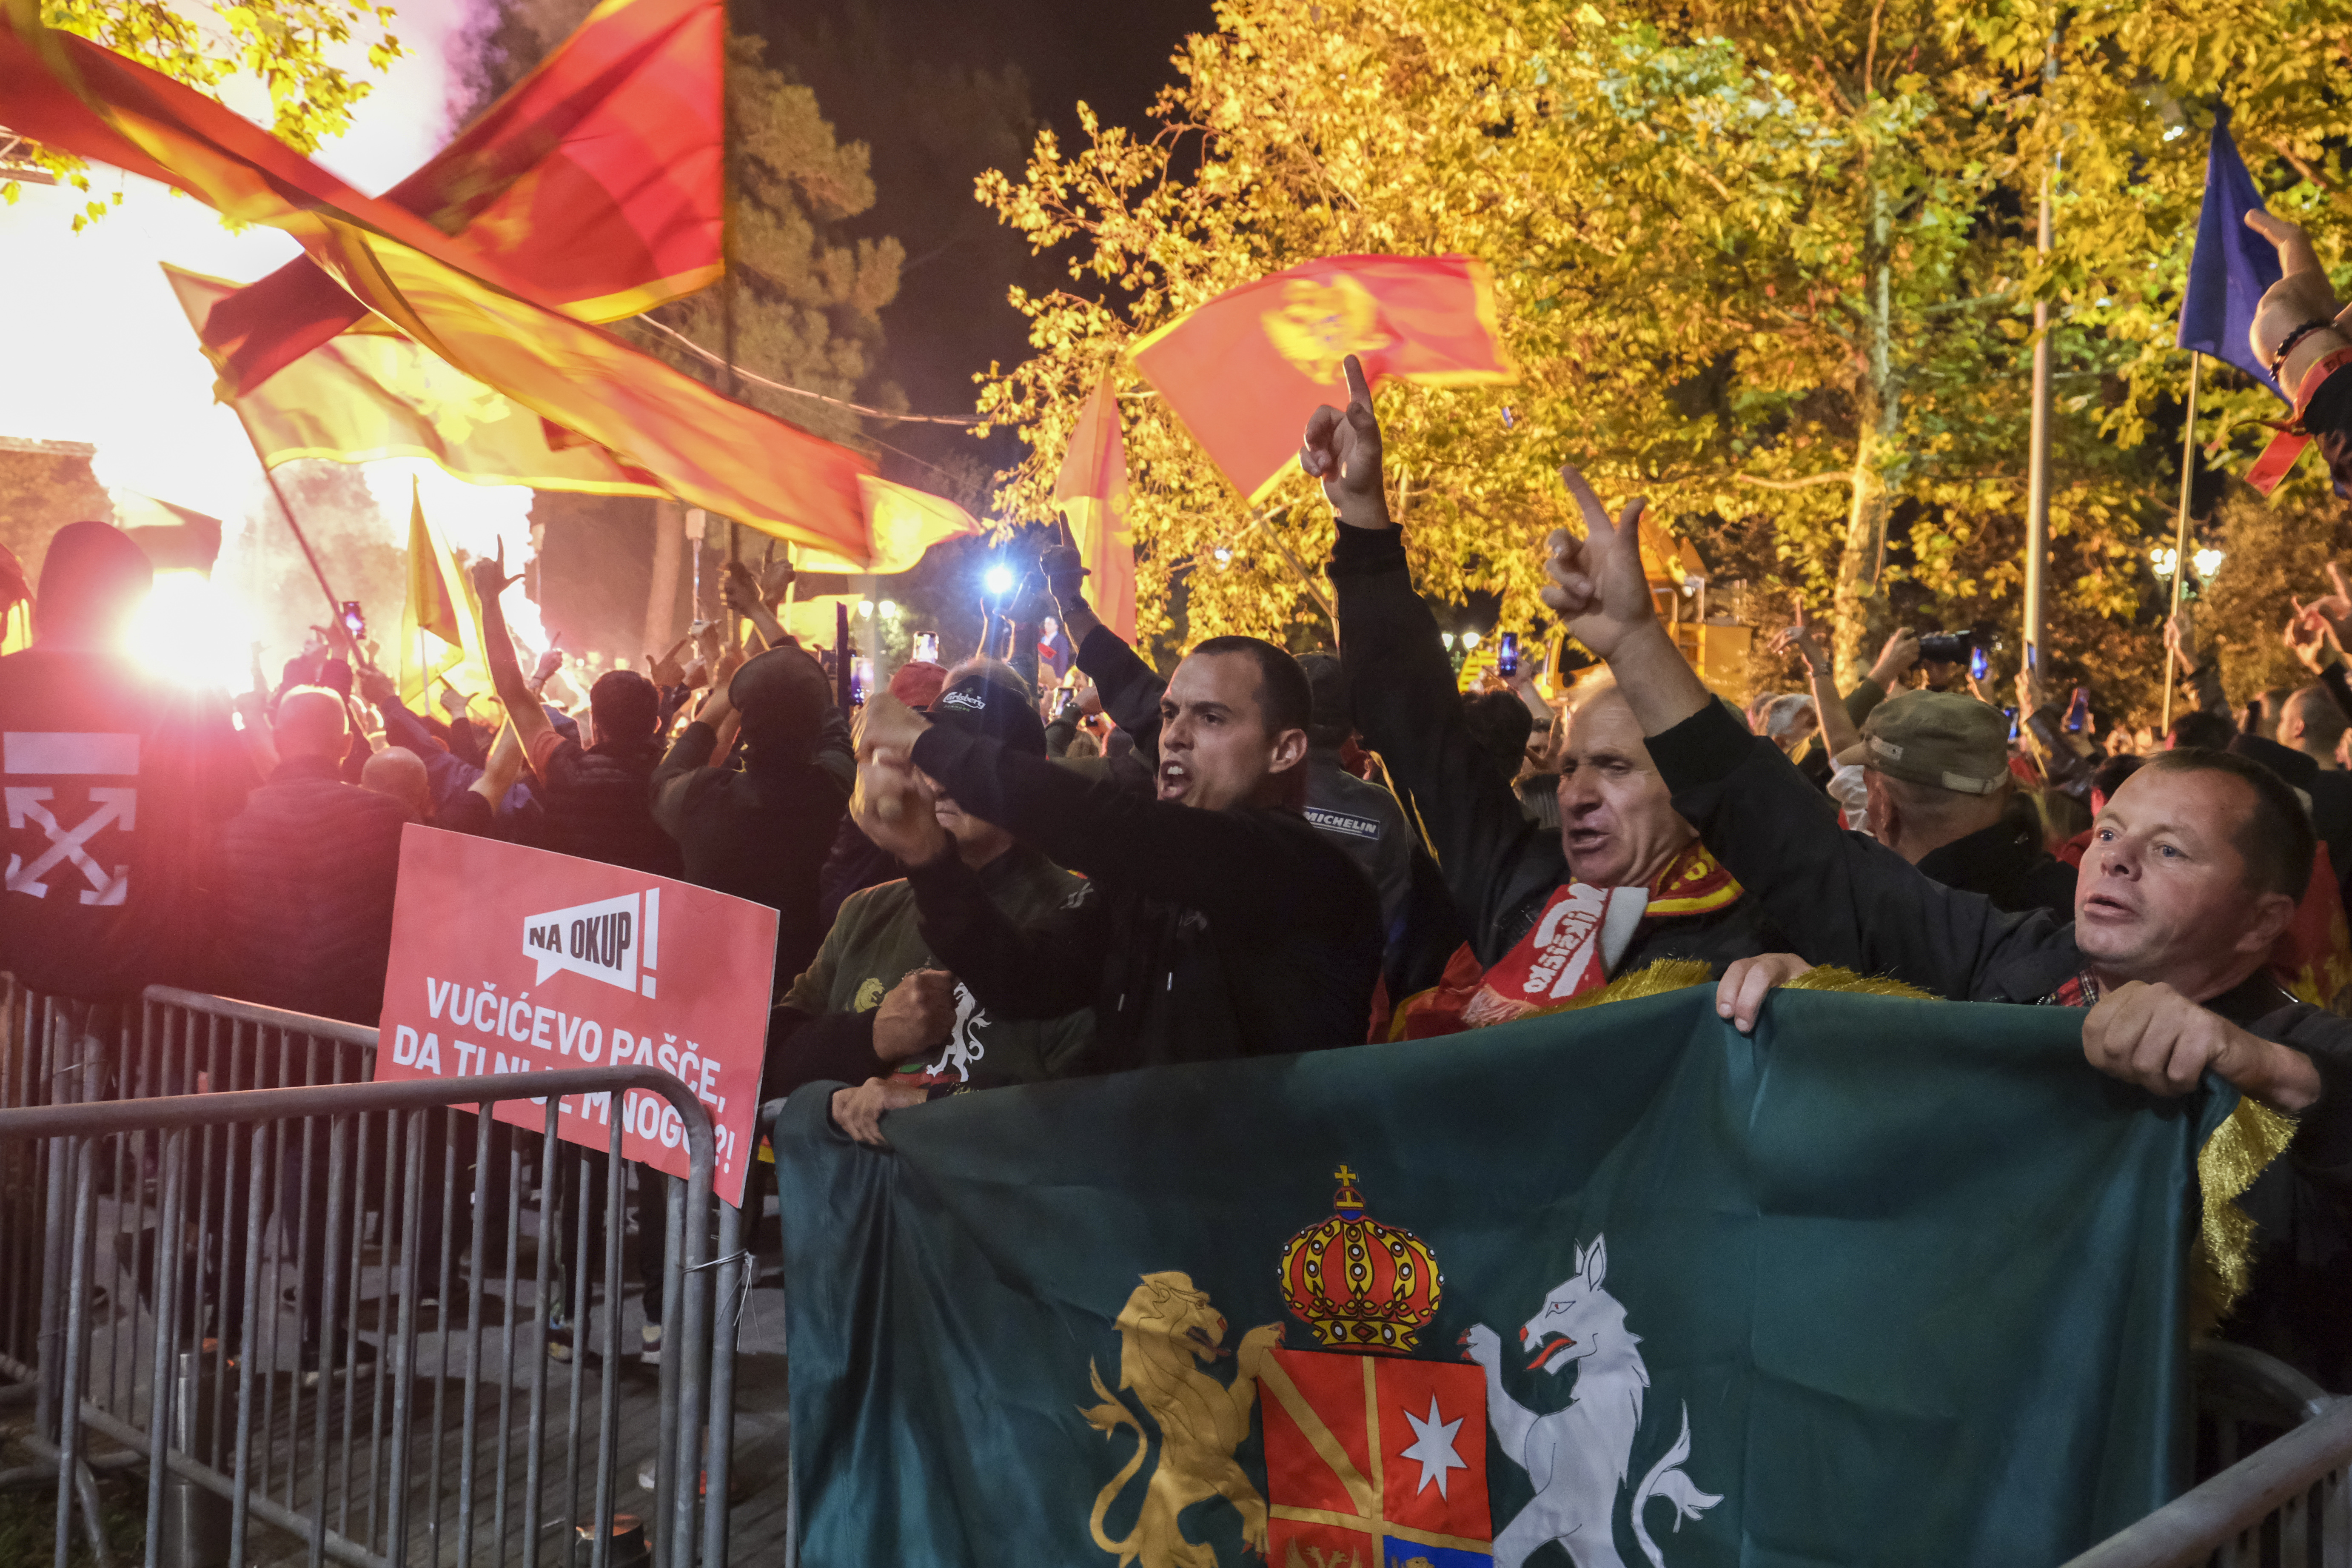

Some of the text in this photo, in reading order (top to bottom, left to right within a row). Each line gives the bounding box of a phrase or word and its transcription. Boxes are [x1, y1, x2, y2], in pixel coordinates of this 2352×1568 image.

[943, 691, 986, 710] Carlsberg
[1303, 811, 1377, 833] MICHELIN
[529, 924, 562, 954] NA
[427, 977, 603, 1063] VUČIĆEVO
[609, 1028, 726, 1113] PAŠČE,
[393, 1024, 735, 1174] DA TI MNOG?!
